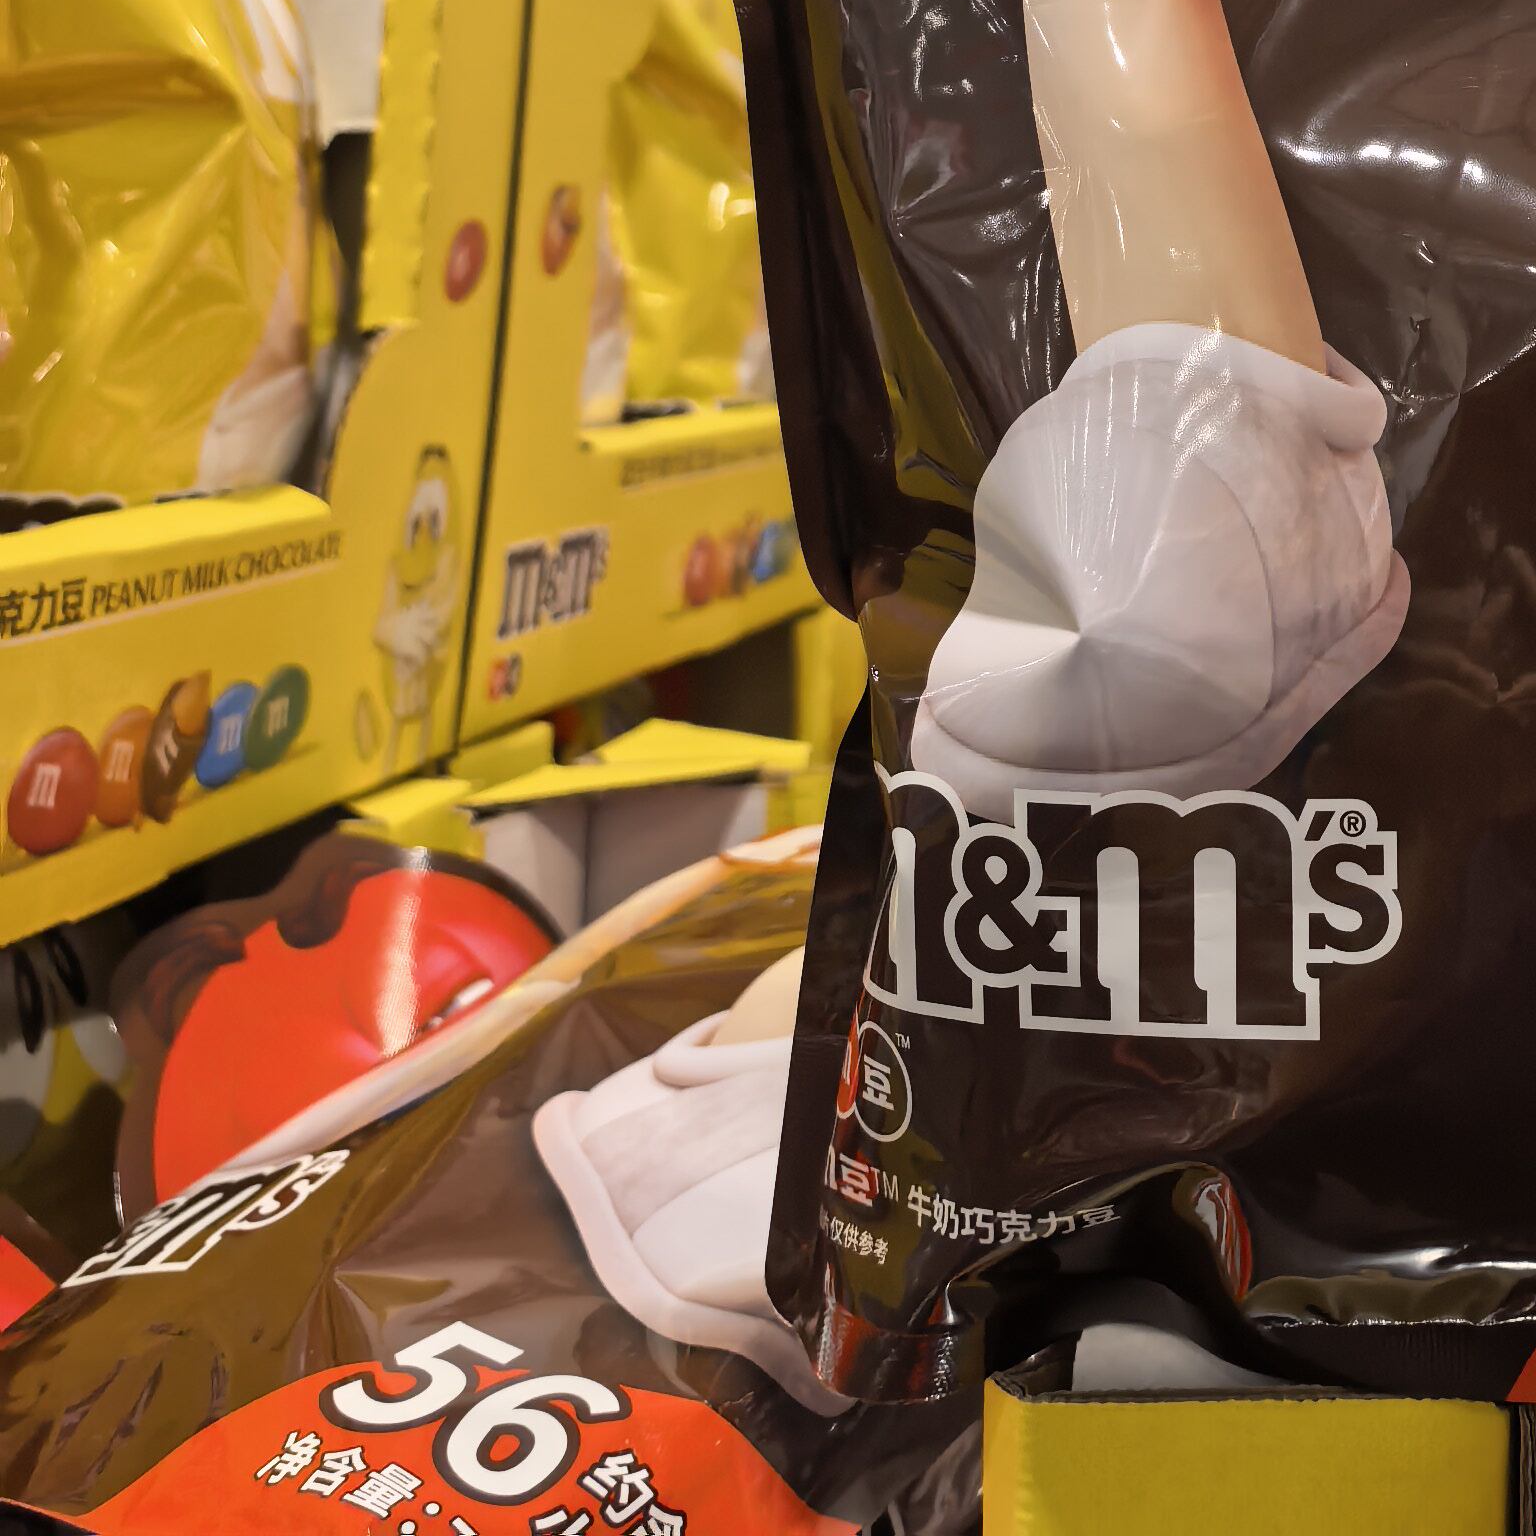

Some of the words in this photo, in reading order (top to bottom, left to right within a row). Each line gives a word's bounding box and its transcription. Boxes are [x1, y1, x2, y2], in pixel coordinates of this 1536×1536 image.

[91, 569, 178, 615] PEANUT
[182, 559, 230, 595] MILK
[907, 1184, 1121, 1245] 牛奶巧克力豆
[332, 1321, 622, 1497] 56
